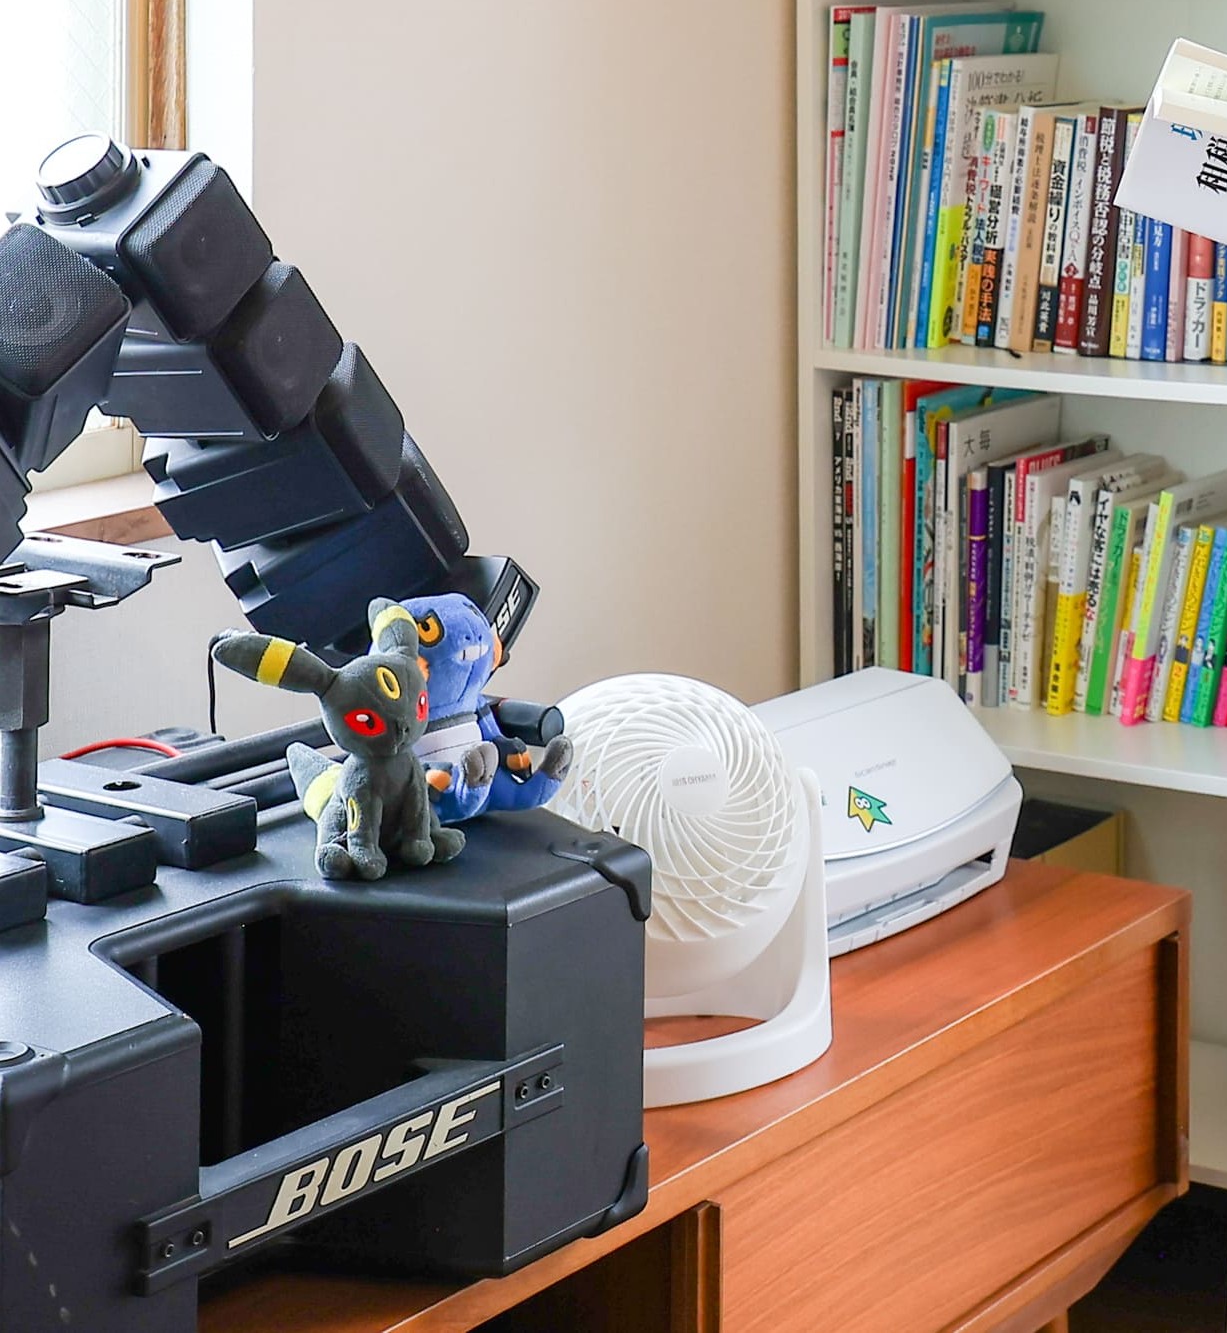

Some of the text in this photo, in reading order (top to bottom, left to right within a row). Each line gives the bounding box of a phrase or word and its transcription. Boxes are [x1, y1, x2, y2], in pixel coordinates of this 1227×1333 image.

[985, 184, 1002, 246] 経営分析
[1045, 158, 1067, 264] 資金繰りの教科書
[1087, 117, 1117, 290] 節税と税務否認の分岐点
[1119, 209, 1134, 259] 申告書
[1191, 281, 1208, 350] ドラッカー
[496, 574, 522, 636] SE
[240, 1086, 492, 1241] BOSE
